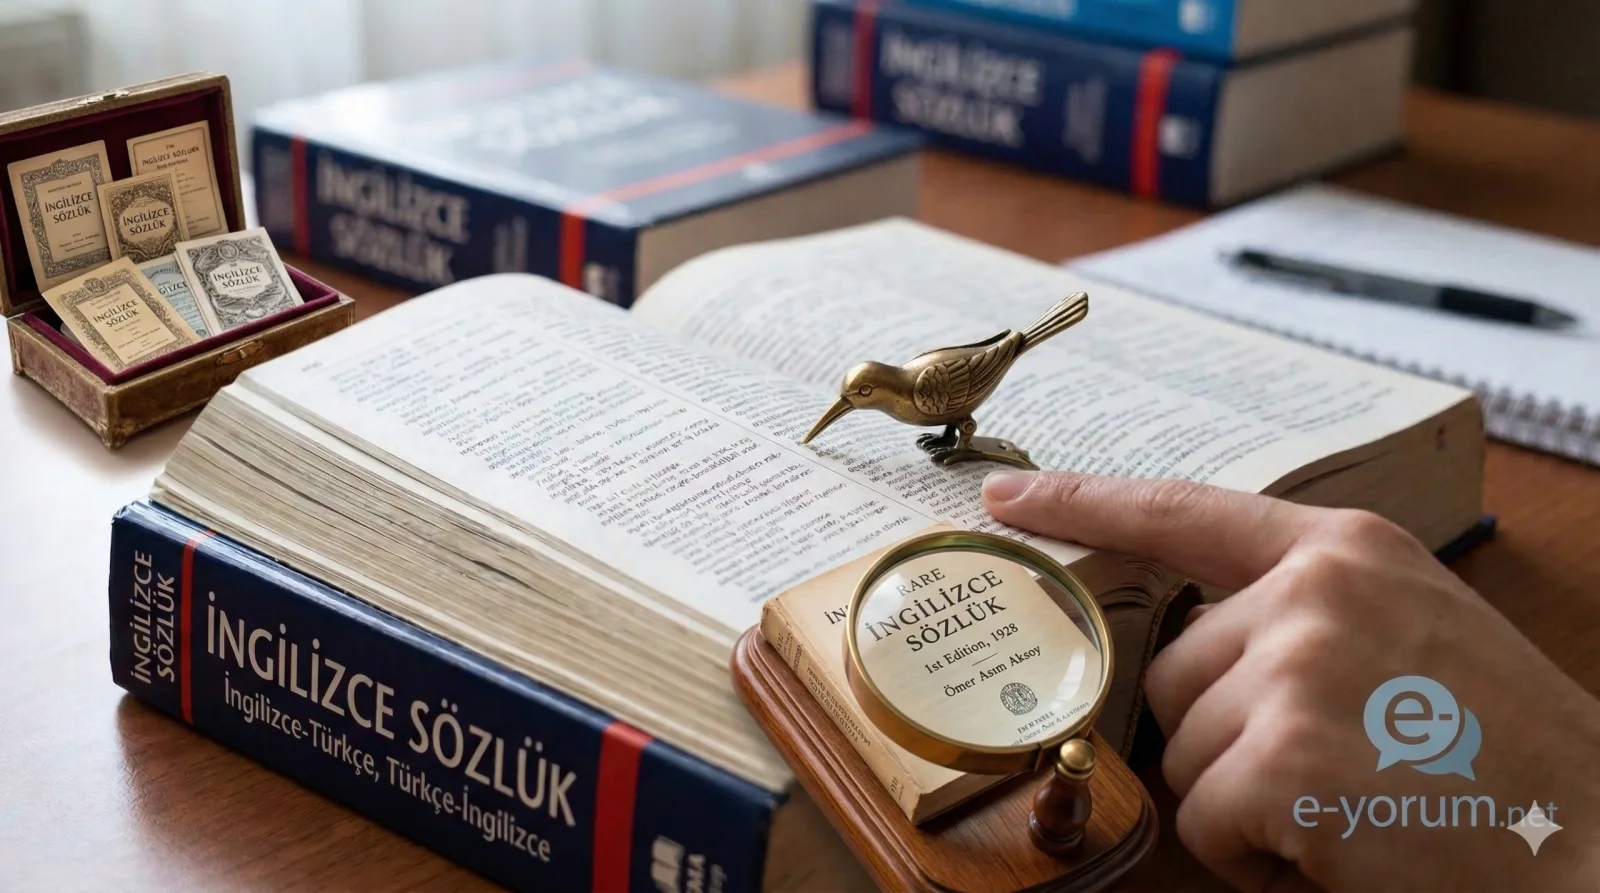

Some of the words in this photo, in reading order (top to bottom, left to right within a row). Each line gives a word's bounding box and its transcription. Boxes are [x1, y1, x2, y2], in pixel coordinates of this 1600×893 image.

[44, 191, 94, 213] İNGİLİZCE
[53, 205, 92, 224] SÖZLÜK
[123, 207, 170, 226] İNGİLİZCE
[129, 219, 166, 236] SÖZLÜK
[213, 265, 262, 282] İNGİLİZCE
[222, 275, 261, 289] SÖZLÜK
[896, 567, 946, 597] RARE
[130, 549, 153, 684] İNGİLİZCE
[824, 604, 849, 625] İN
[864, 570, 1004, 641] İNGİLİZCE
[906, 596, 1007, 652] SÖZLÜK
[154, 574, 175, 683] SÖZLÜK
[924, 659, 944, 674] 1st
[943, 640, 991, 665] Edition,
[990, 623, 1019, 642] 1928
[943, 677, 976, 697] Ömer
[979, 663, 1008, 681] Asım
[1008, 644, 1042, 667] Aksoy
[207, 591, 396, 740] İNGİLİZCE
[408, 698, 578, 827] SÖZLÜK
[224, 671, 380, 783] İngilizce-Türkçe,
[386, 757, 551, 862] Türkçe-İngilizce
